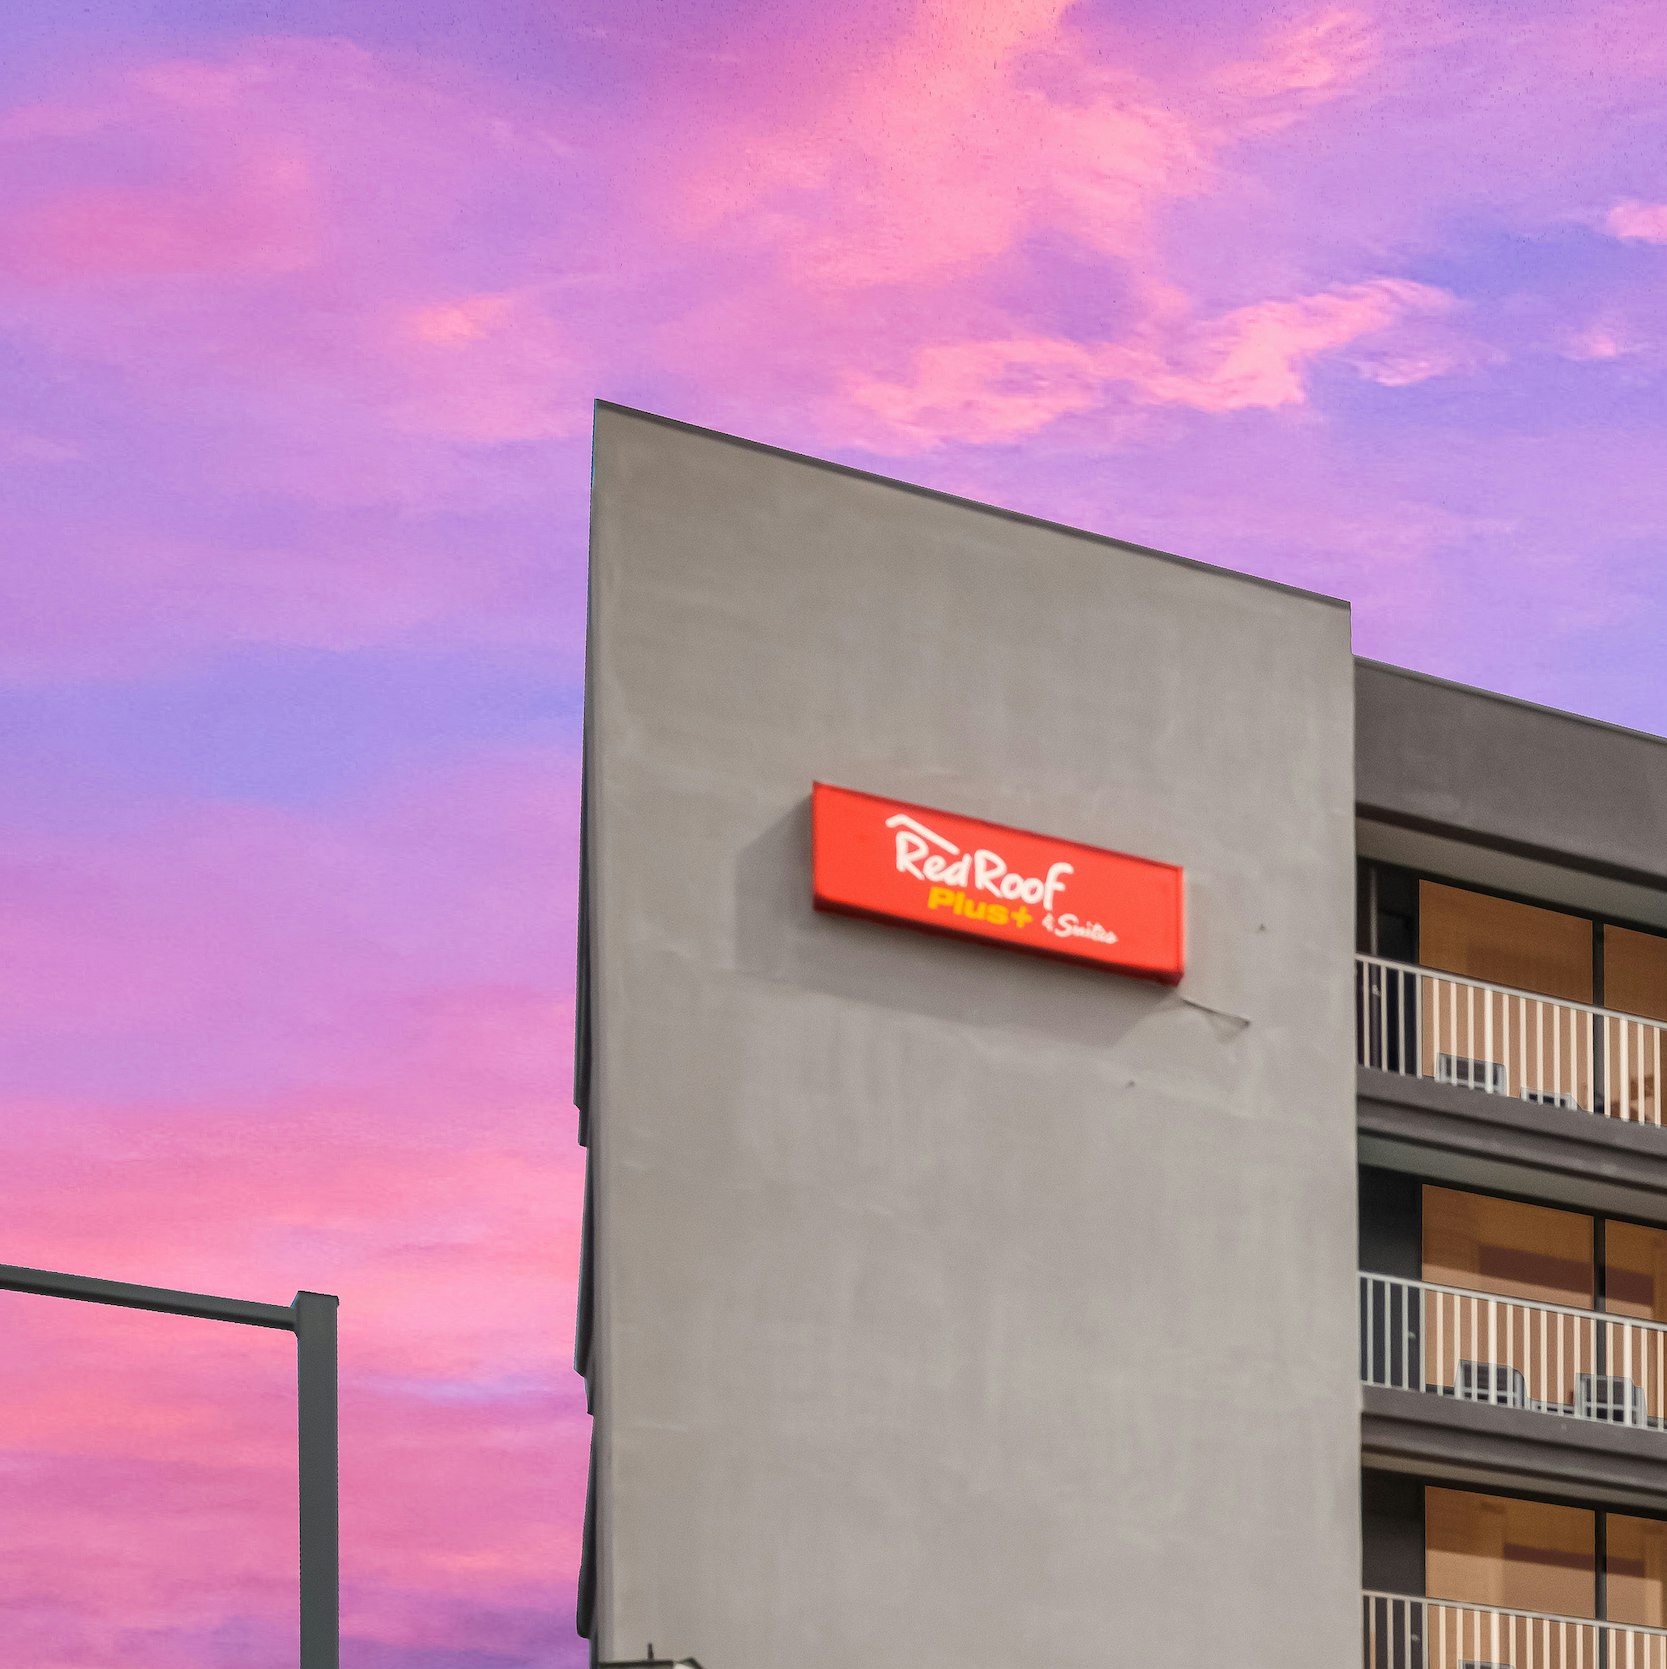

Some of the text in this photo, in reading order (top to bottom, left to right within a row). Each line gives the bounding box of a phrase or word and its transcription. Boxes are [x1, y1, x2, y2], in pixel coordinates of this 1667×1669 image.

[895, 830, 1074, 911] Red Roof
[928, 886, 1033, 928] Plus+
[1054, 913, 1119, 945] Suites
